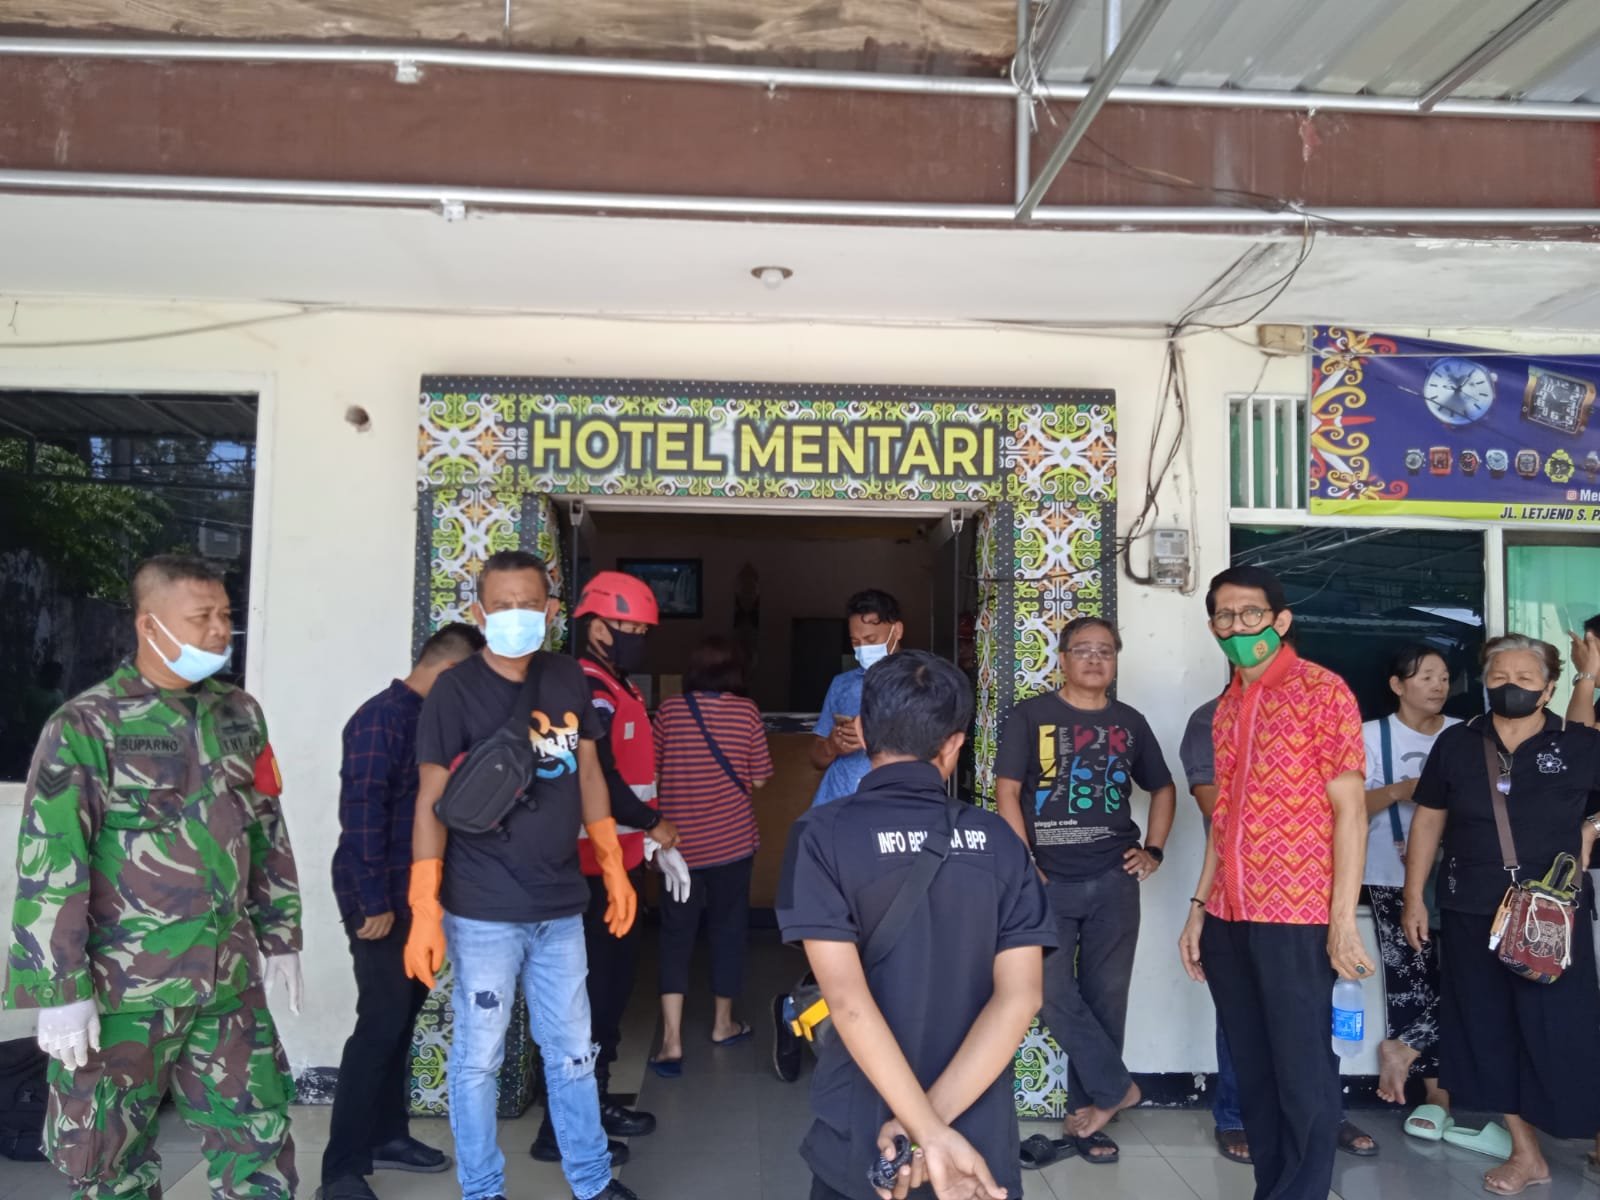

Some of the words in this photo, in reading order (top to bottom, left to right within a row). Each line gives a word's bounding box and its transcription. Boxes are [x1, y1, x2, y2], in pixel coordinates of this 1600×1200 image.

[534, 418, 723, 473] HOTEL
[740, 423, 995, 477] MENTARI
[1500, 507, 1517, 518] JL.
[1521, 507, 1574, 520] LETJEND
[1577, 509, 1587, 520] S.
[1591, 509, 1600, 520] P
[120, 738, 178, 752] SUPARNO
[877, 831, 906, 853] INFO
[964, 829, 987, 850] BPP
